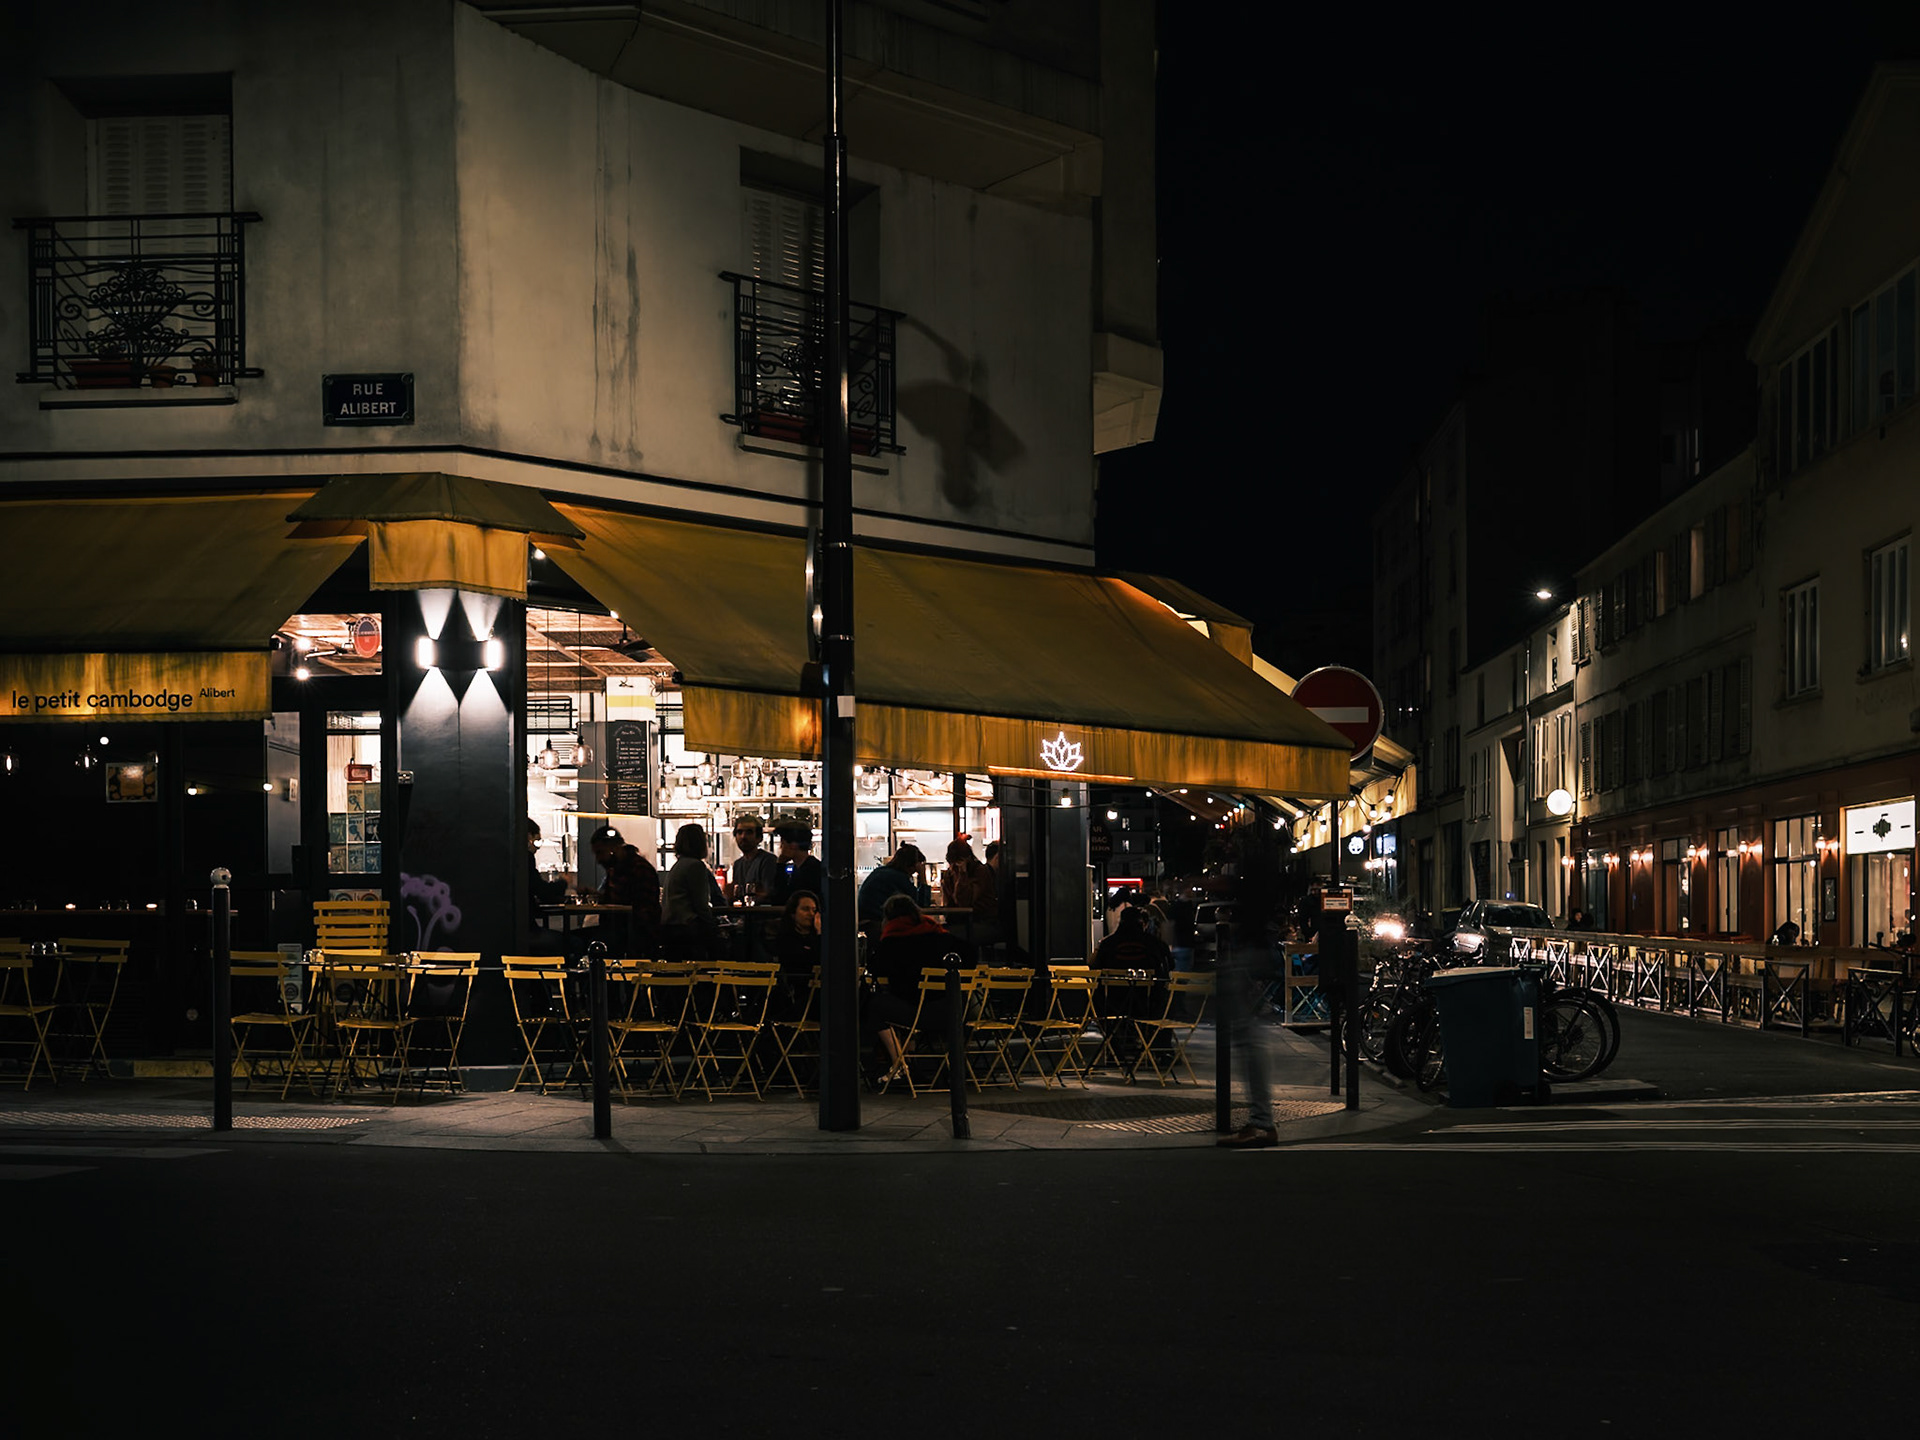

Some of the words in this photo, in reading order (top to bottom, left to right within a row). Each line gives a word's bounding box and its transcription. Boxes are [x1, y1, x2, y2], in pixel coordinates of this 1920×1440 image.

[353, 383, 384, 395] RUE
[340, 402, 396, 415] ALIBERT
[12, 690, 29, 708] le
[35, 689, 80, 712] petit
[86, 689, 193, 712] cambodge
[199, 688, 236, 698] Alibert
